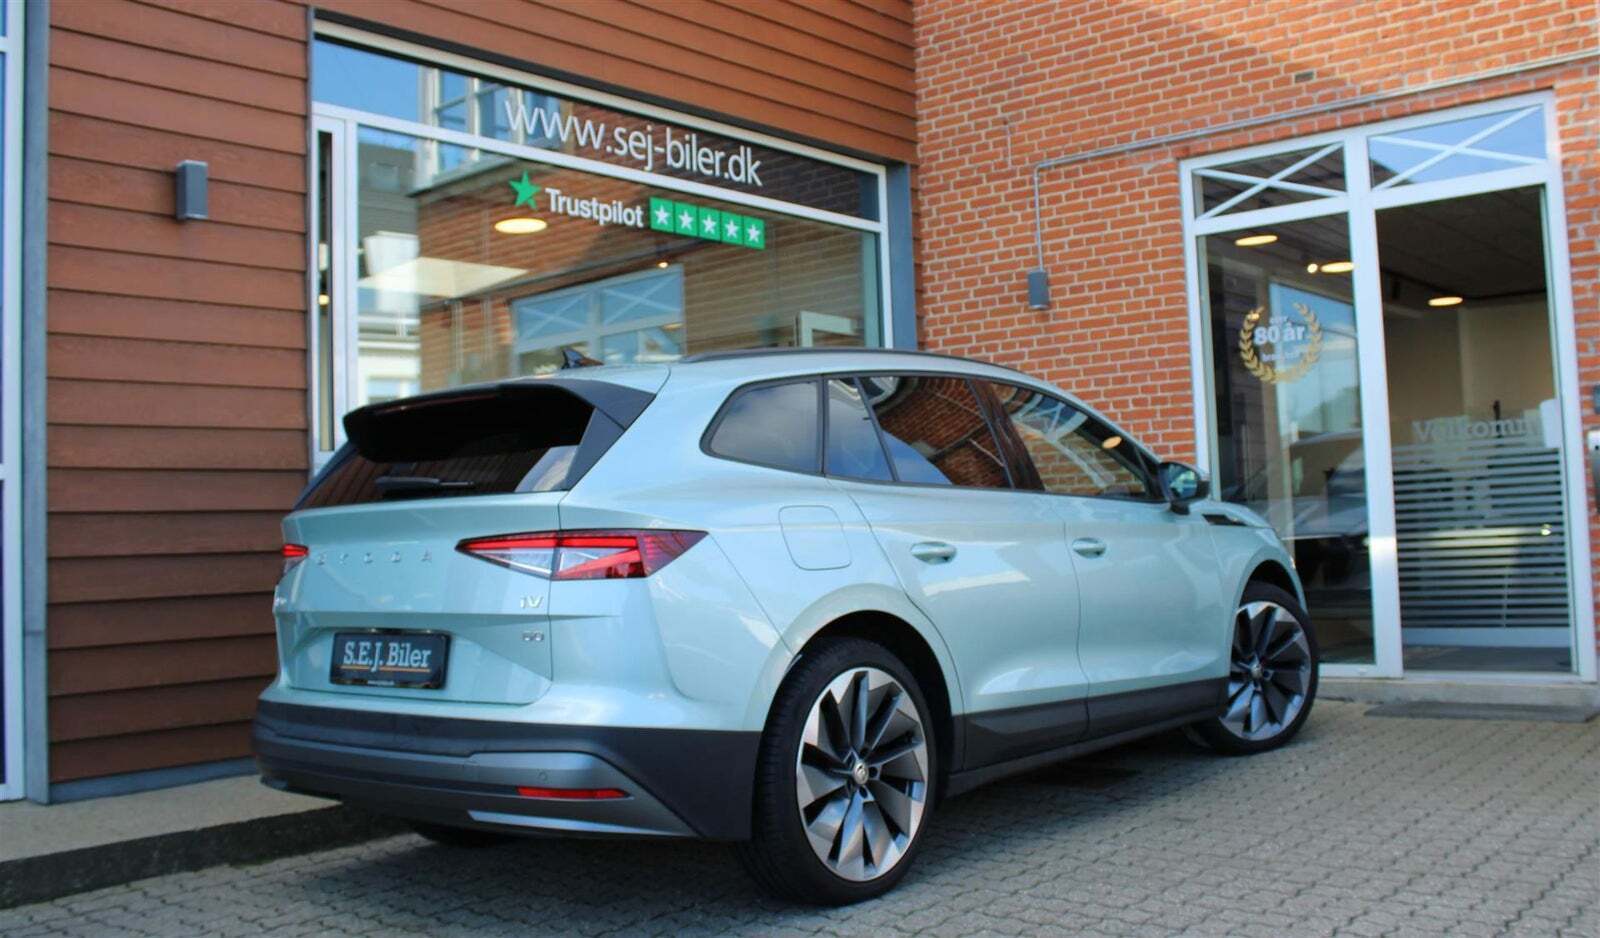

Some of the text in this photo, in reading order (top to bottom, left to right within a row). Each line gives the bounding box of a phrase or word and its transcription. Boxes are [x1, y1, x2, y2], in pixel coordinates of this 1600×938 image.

[504, 99, 763, 187] www.sej-biler.dk
[545, 186, 645, 228] Trustpilot
[1254, 325, 1280, 346] 80
[1283, 320, 1306, 343] år
[343, 640, 432, 673] S.E.J. Biler
